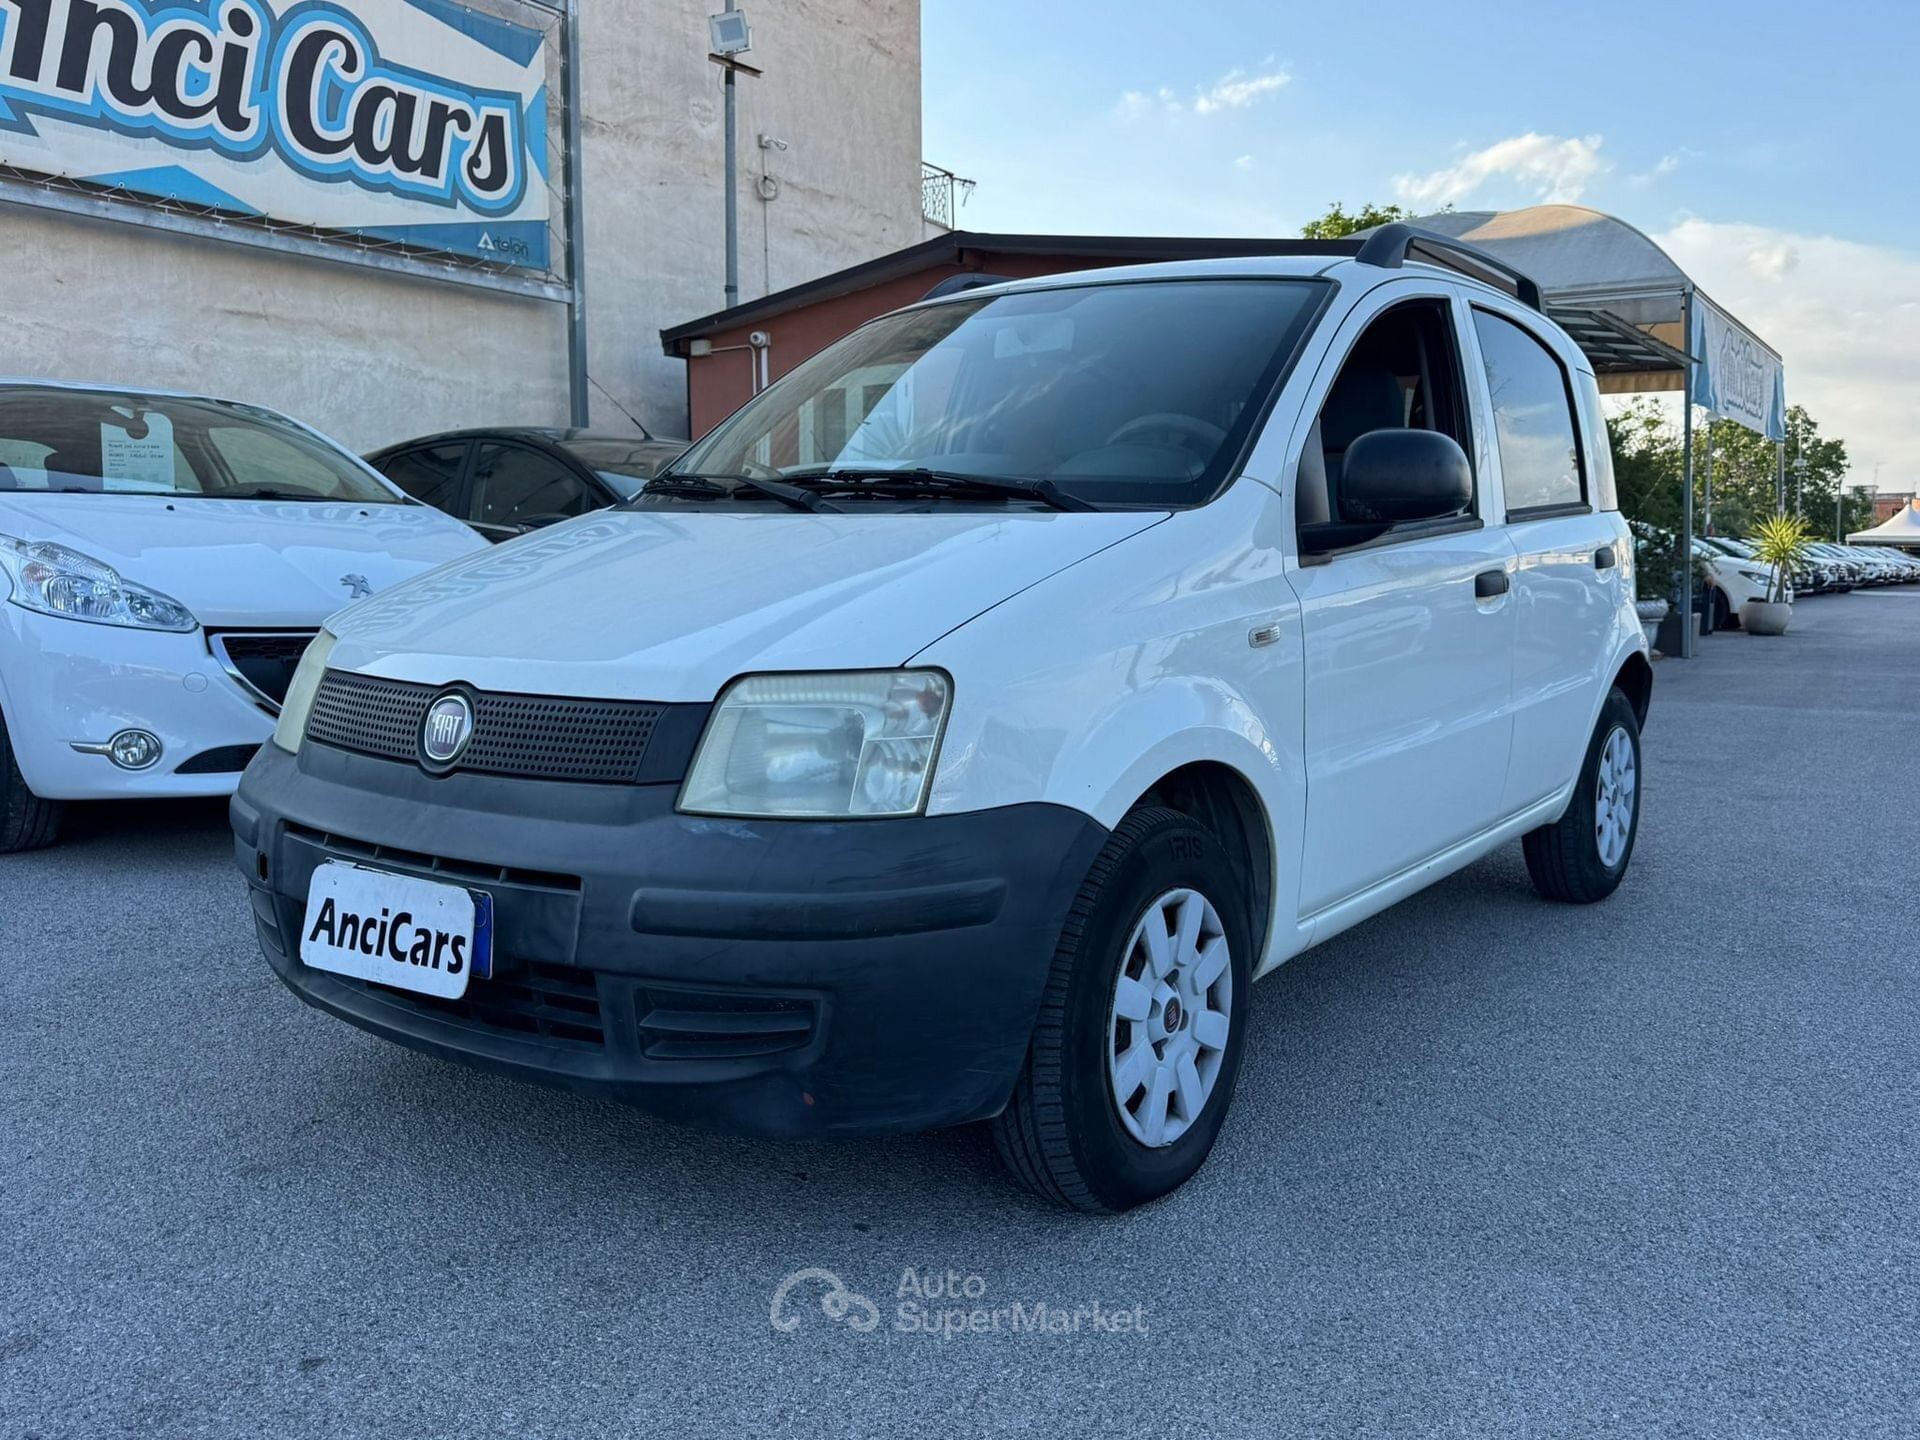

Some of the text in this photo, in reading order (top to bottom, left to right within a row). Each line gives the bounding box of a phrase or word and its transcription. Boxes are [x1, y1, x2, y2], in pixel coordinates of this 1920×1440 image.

[286, 29, 509, 193] Cars
[432, 713, 463, 745] FIAT
[308, 897, 466, 974] AnciCars
